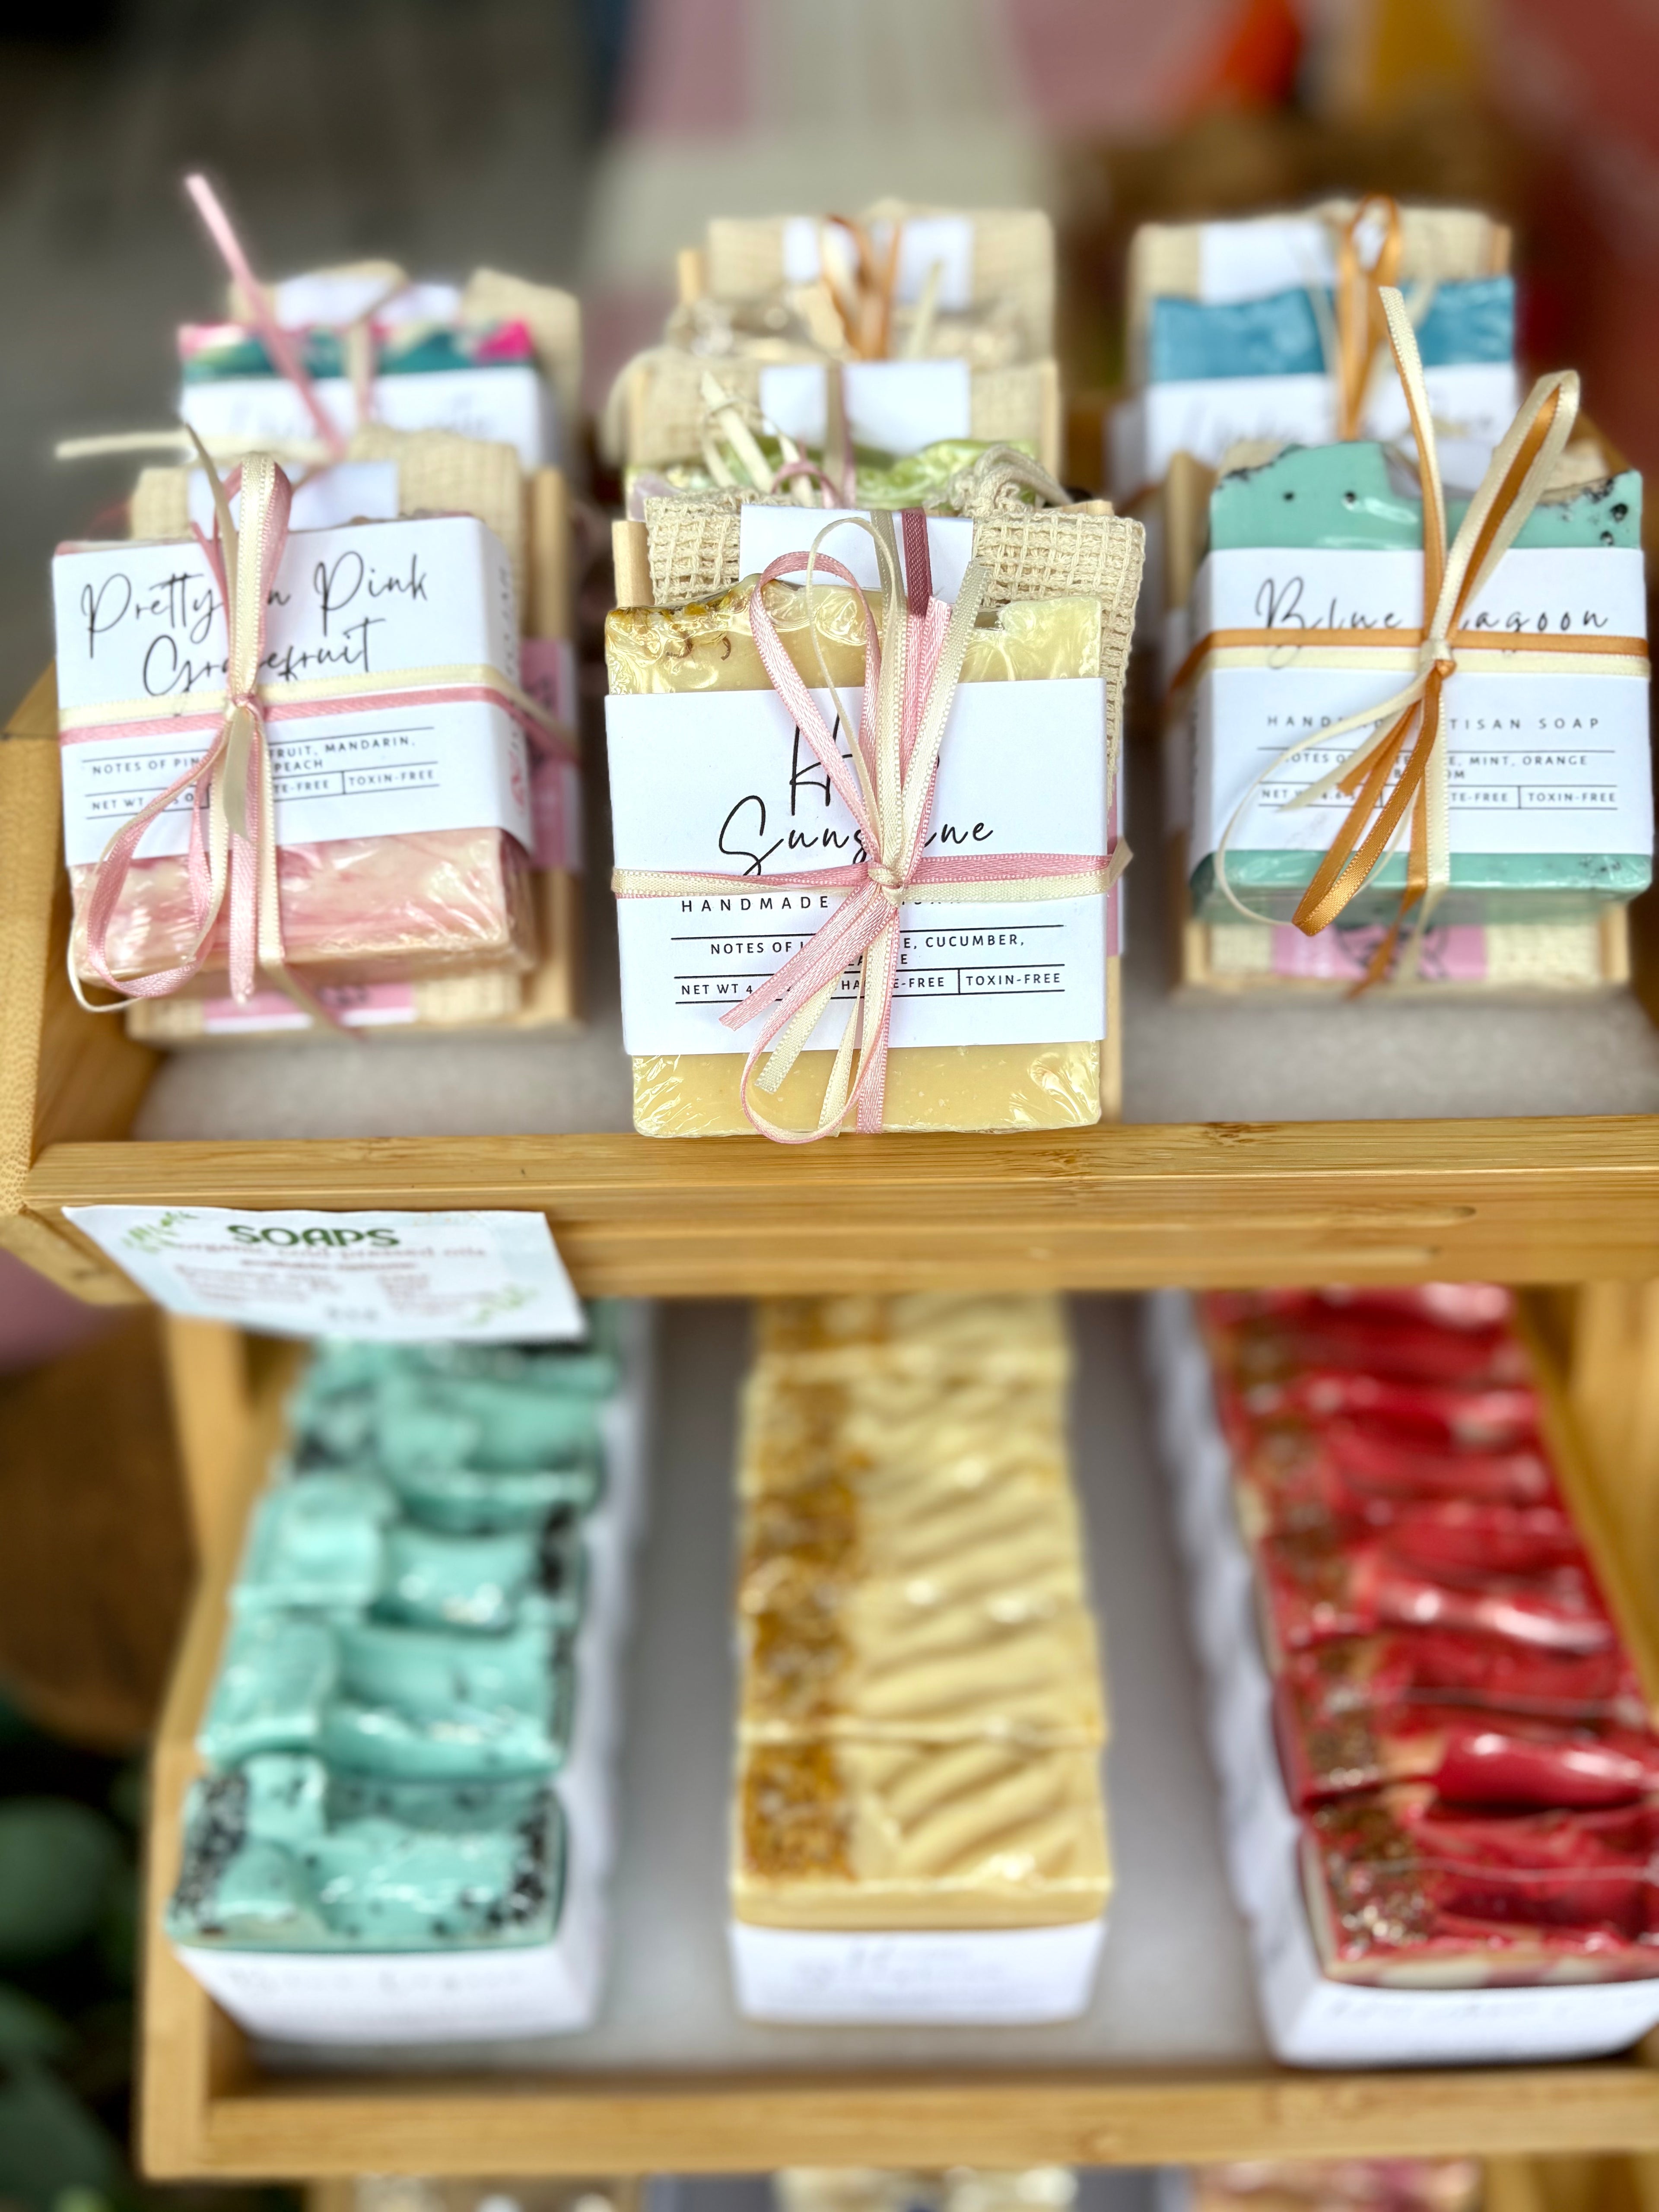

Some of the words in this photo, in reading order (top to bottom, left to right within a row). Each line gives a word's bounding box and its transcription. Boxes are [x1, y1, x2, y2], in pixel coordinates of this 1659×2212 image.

[81, 572, 224, 658] Pretty
[314, 551, 427, 637] Pink
[143, 617, 386, 696] Grefruit
[1449, 719, 1521, 730] TISAN
[1538, 718, 1599, 730] SOAP
[92, 761, 141, 775] NOTES
[149, 759, 166, 769] OF
[174, 757, 200, 768] PIN
[325, 736, 415, 753] MANDARIN,
[274, 759, 323, 772] PEACH
[1285, 753, 1329, 763] OTES
[1470, 756, 1515, 767] MINT,
[1522, 756, 1588, 766] ORANGE
[92, 799, 117, 810] NET
[124, 797, 144, 807] WT
[349, 769, 434, 786] TOXIN-FREE
[1262, 790, 1288, 798] NET
[1528, 792, 1617, 804] TOXIN-FREE
[719, 795, 994, 876] Sunsne
[681, 896, 829, 912] HANDMADE
[711, 942, 764, 954] NOTES
[772, 941, 792, 953] OF
[925, 934, 1024, 948] CUCUMBER,
[681, 985, 710, 995] NET
[717, 983, 739, 994] WT
[841, 977, 944, 990] HAE-FREE
[966, 973, 1061, 986] TOXIN-FREE
[227, 1225, 400, 1246] SOAPS
